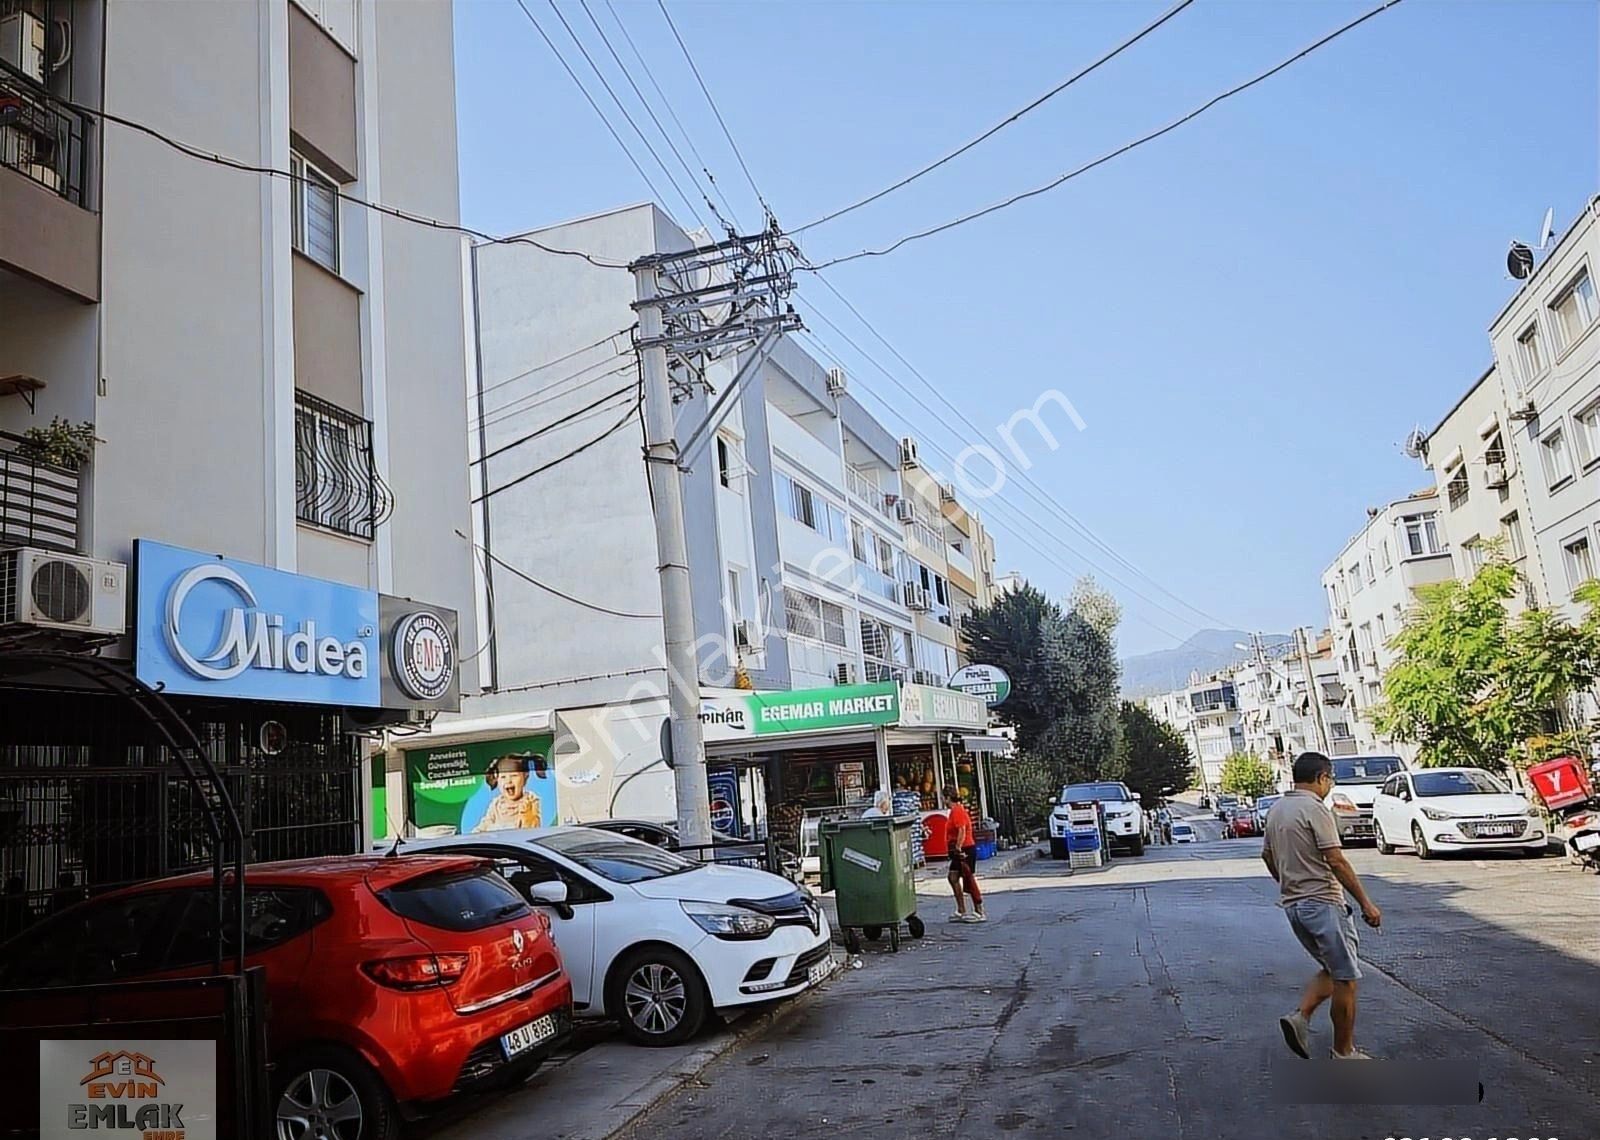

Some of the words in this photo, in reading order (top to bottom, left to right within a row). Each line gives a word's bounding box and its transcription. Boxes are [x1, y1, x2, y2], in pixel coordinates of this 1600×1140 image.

[163, 563, 369, 680] Midea
[761, 702, 824, 722] EGEMAR
[829, 695, 894, 716] MARKET
[429, 751, 466, 760] Annelerin
